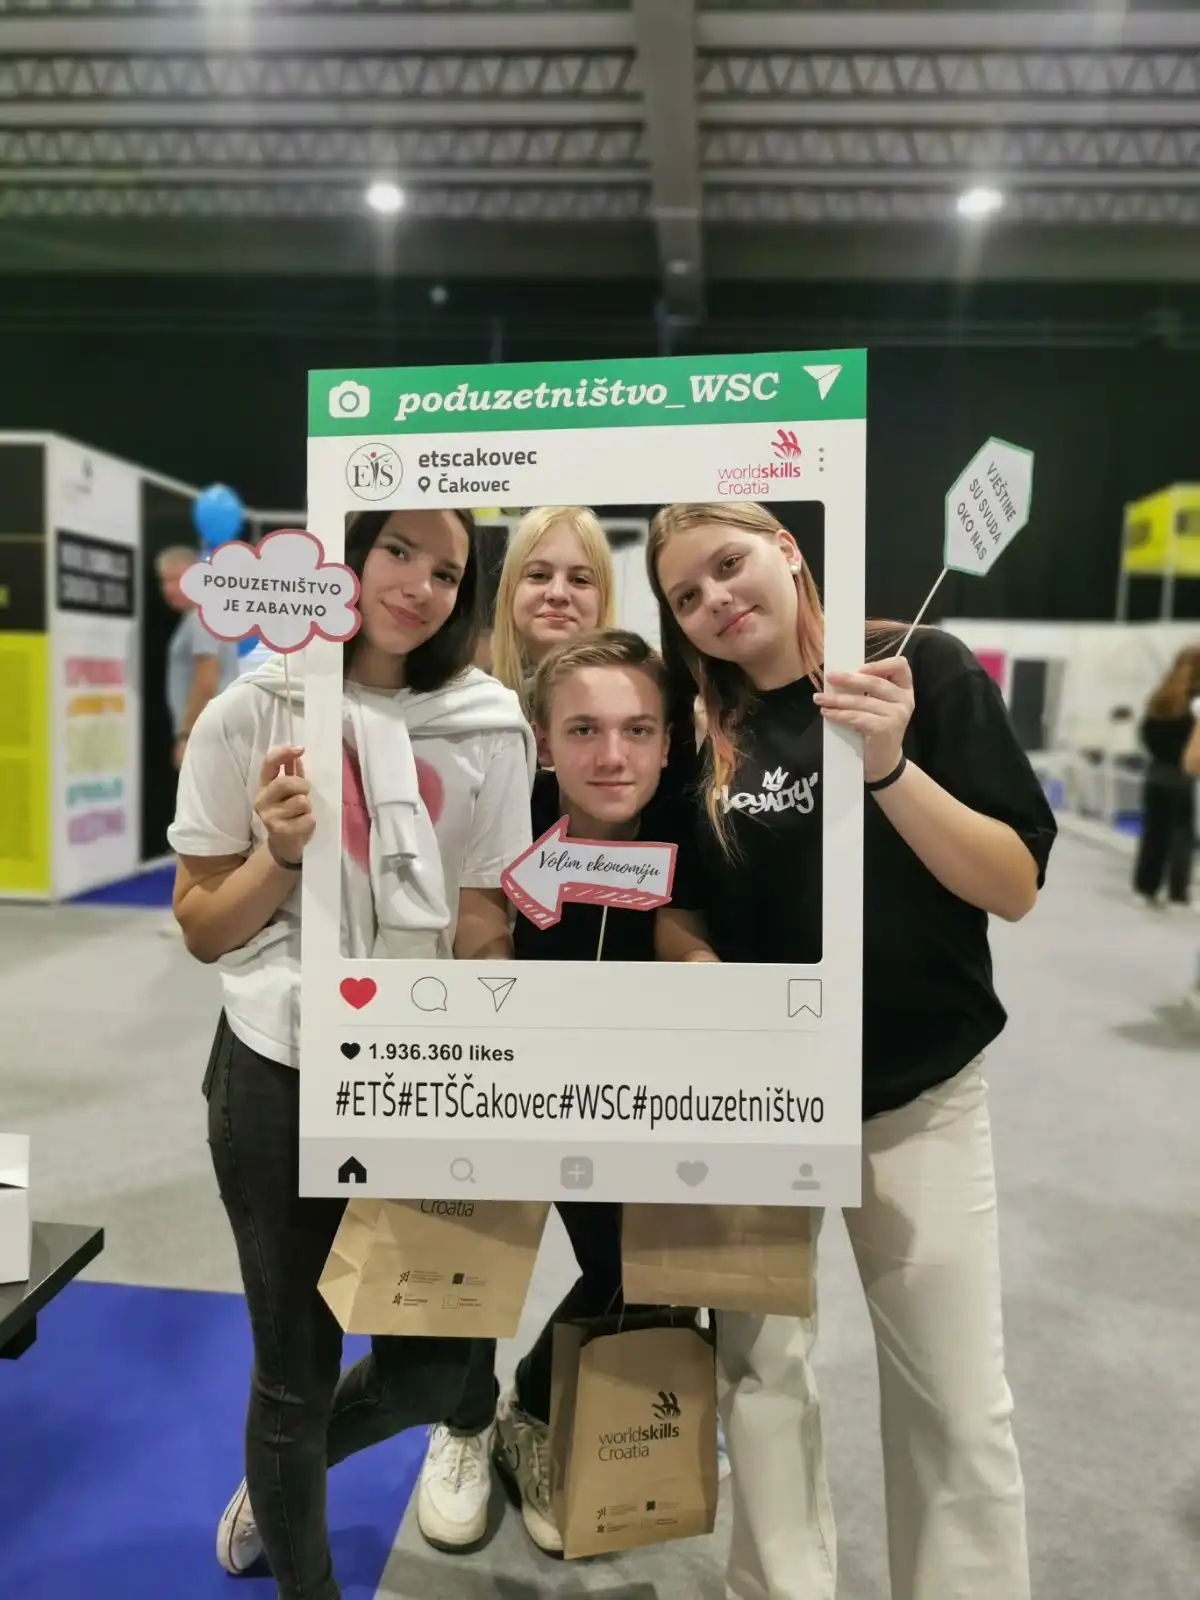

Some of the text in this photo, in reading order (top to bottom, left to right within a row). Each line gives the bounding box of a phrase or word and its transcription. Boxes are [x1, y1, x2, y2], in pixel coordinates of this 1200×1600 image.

[394, 372, 780, 422] poduzetništvo_WSC
[418, 448, 537, 468] etscakovec
[718, 462, 801, 480] worldskills
[438, 473, 510, 493] Čakovec
[717, 480, 770, 495] Croatia
[986, 461, 1017, 522] VJEŠTINE
[969, 479, 1003, 545] SU SVUDA
[956, 502, 987, 561] OKO NAS
[203, 574, 342, 596] PODUZETNIŠTVO
[222, 599, 327, 617] JE ZABAVNO
[539, 850, 661, 885] Volim ekonomiju
[369, 1043, 514, 1061] 1.936.360 likes
[598, 1422, 681, 1446] worldskills
[598, 1444, 650, 1462] Croatia
